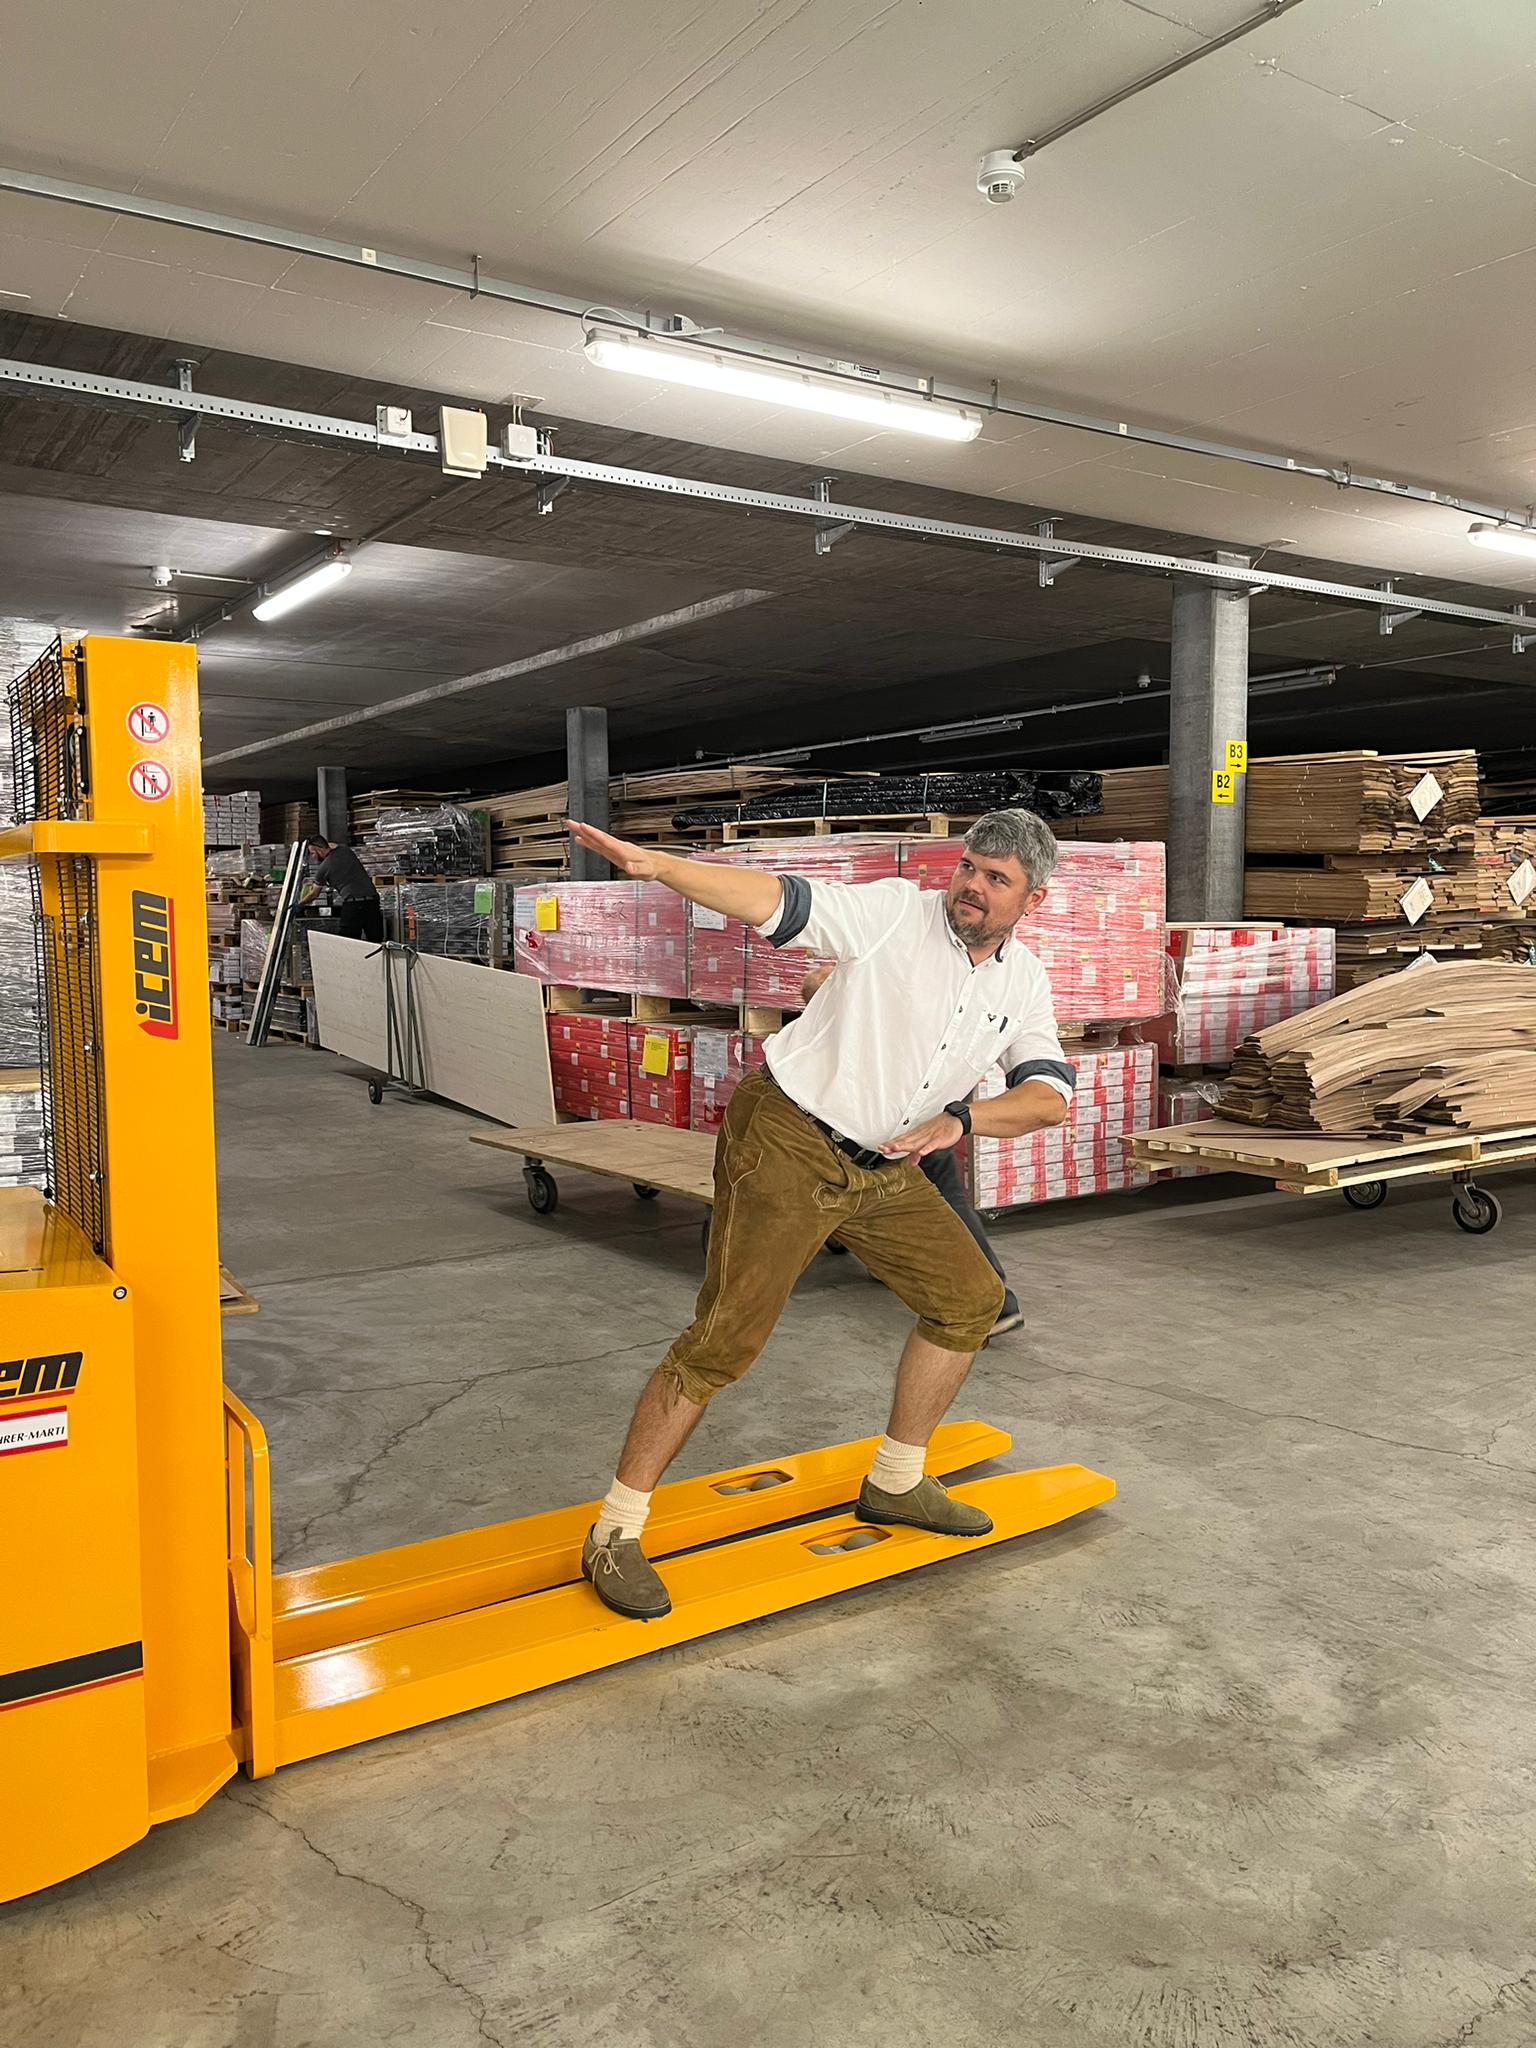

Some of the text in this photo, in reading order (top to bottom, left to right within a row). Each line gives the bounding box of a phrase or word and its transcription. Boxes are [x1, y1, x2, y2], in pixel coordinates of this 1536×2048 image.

[1229, 744, 1243, 759] B3
[1216, 774, 1230, 789] B2
[132, 889, 172, 1023] icem
